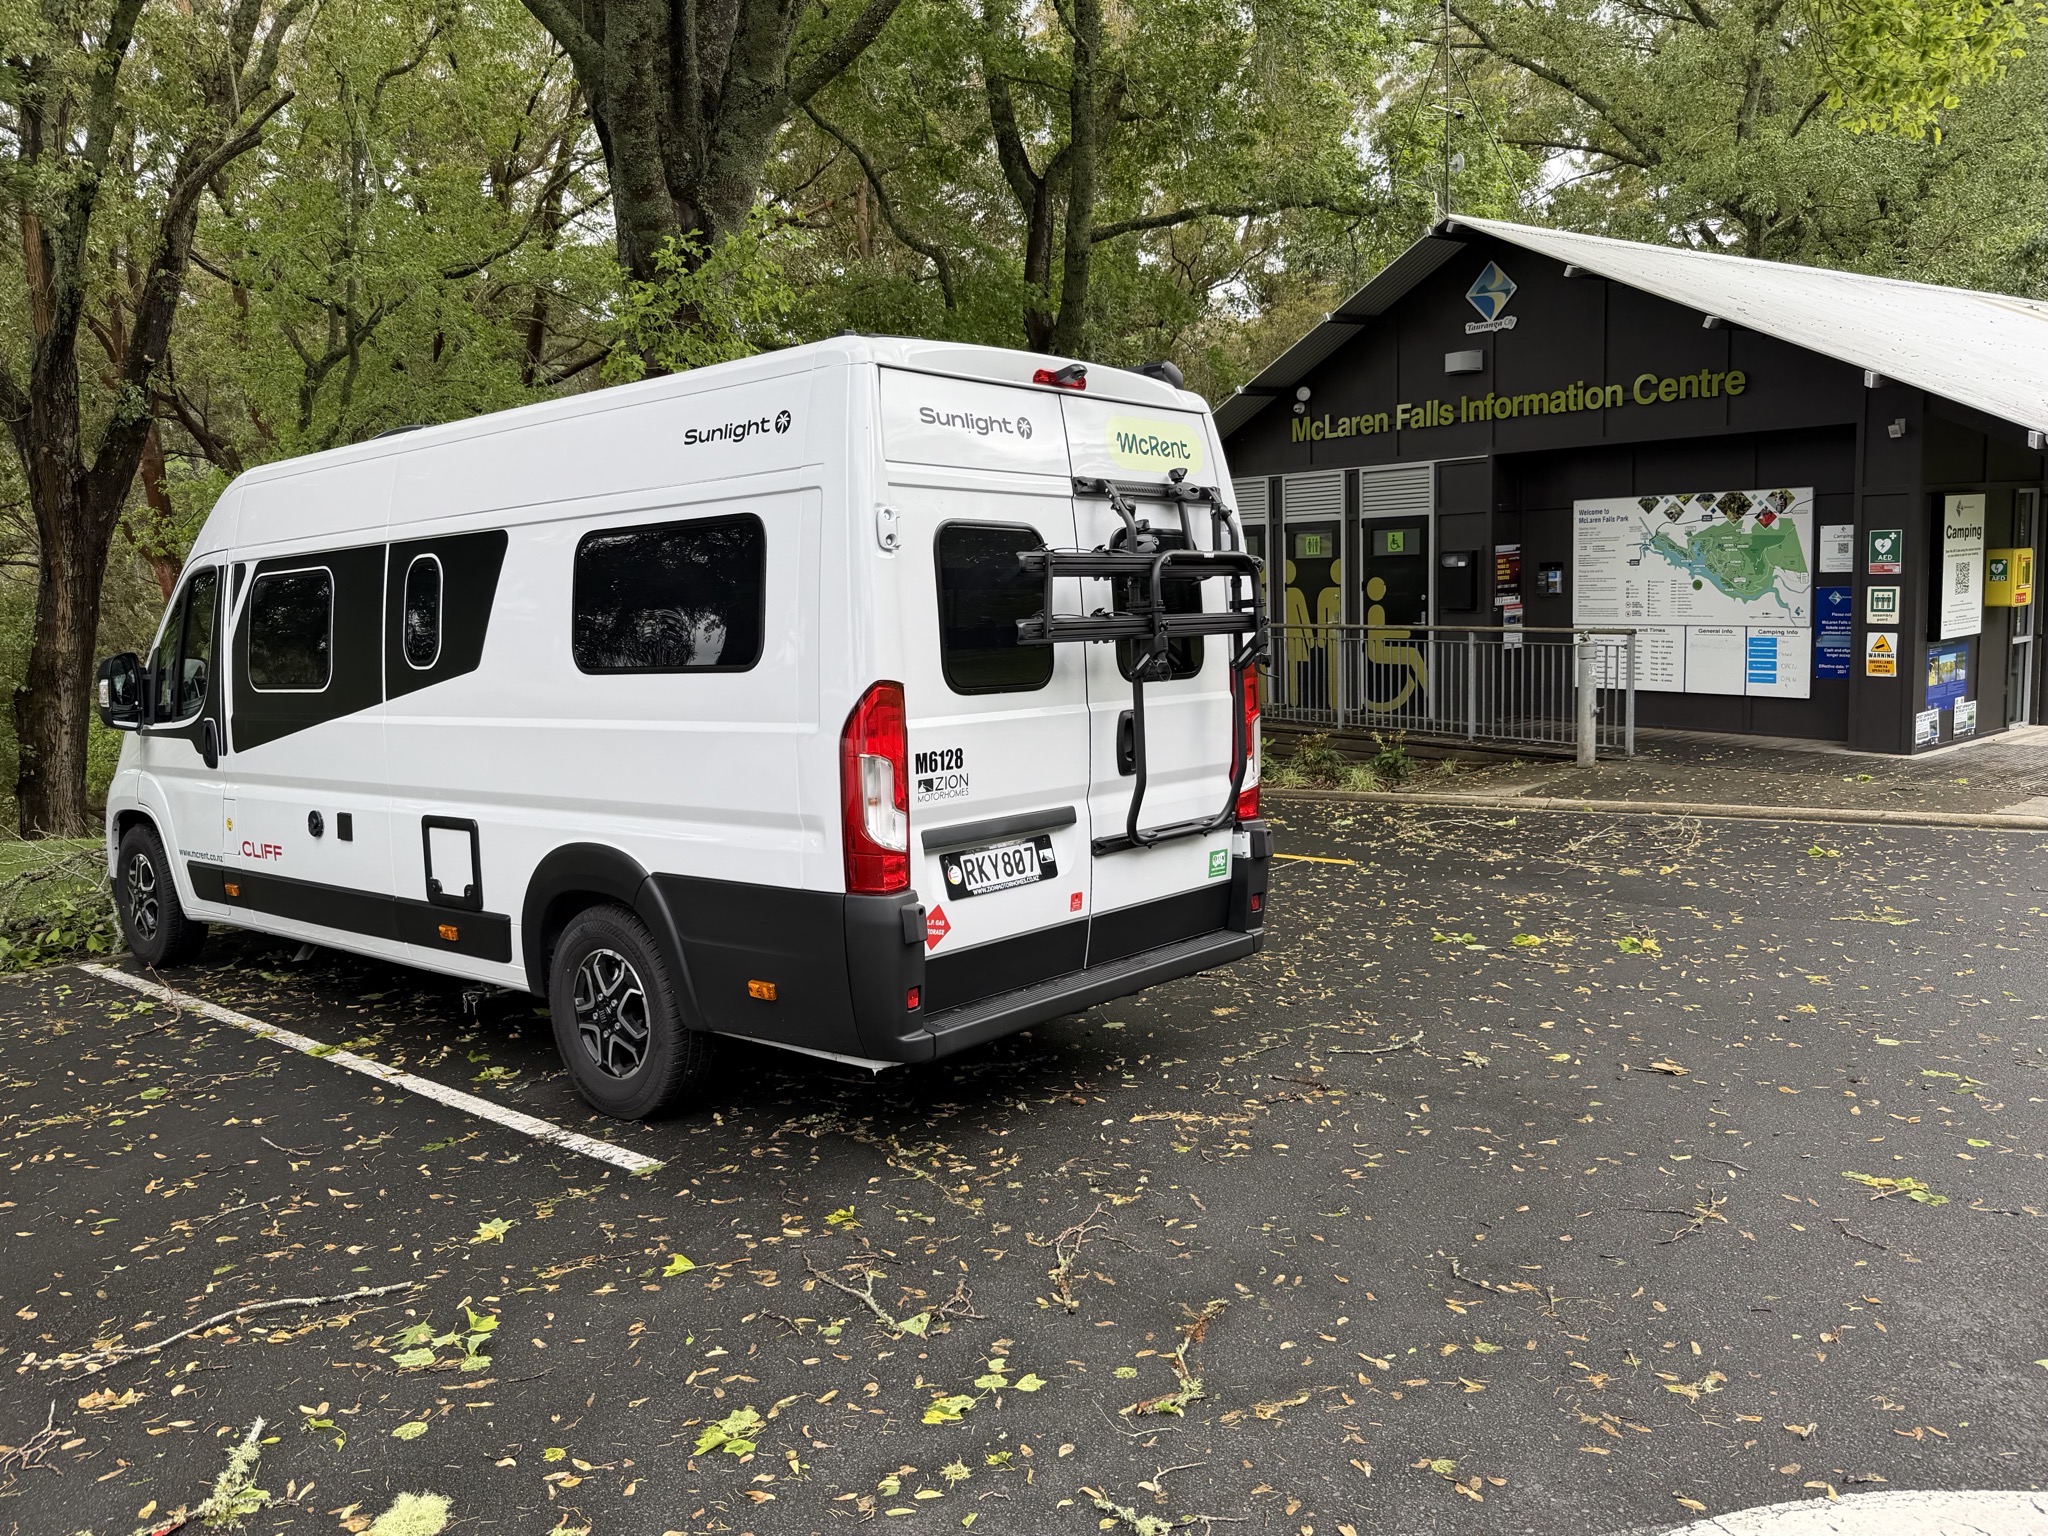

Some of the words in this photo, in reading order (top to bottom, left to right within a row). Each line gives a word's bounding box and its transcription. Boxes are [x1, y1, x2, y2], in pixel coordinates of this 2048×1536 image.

[1467, 321, 1502, 332] Tauranga
[1292, 411, 1389, 442] McLaren
[1396, 400, 1454, 430] Falls
[1461, 380, 1624, 423] Information
[1633, 368, 1746, 405] Centre
[684, 417, 770, 445] Sunlight
[920, 406, 1014, 436] Sunlight
[1116, 432, 1190, 459] McRent
[1946, 524, 1981, 540] Camping
[915, 748, 964, 774] M6128
[934, 773, 969, 791] ZION
[918, 787, 969, 803] MOTORHOMES
[179, 849, 223, 862] www.mcrent.co.nz
[242, 841, 282, 861] CLIFF
[962, 846, 1034, 886] RKY807
[972, 875, 1040, 895] WWW.ZIONMOTORHOMES.CO.NZ
